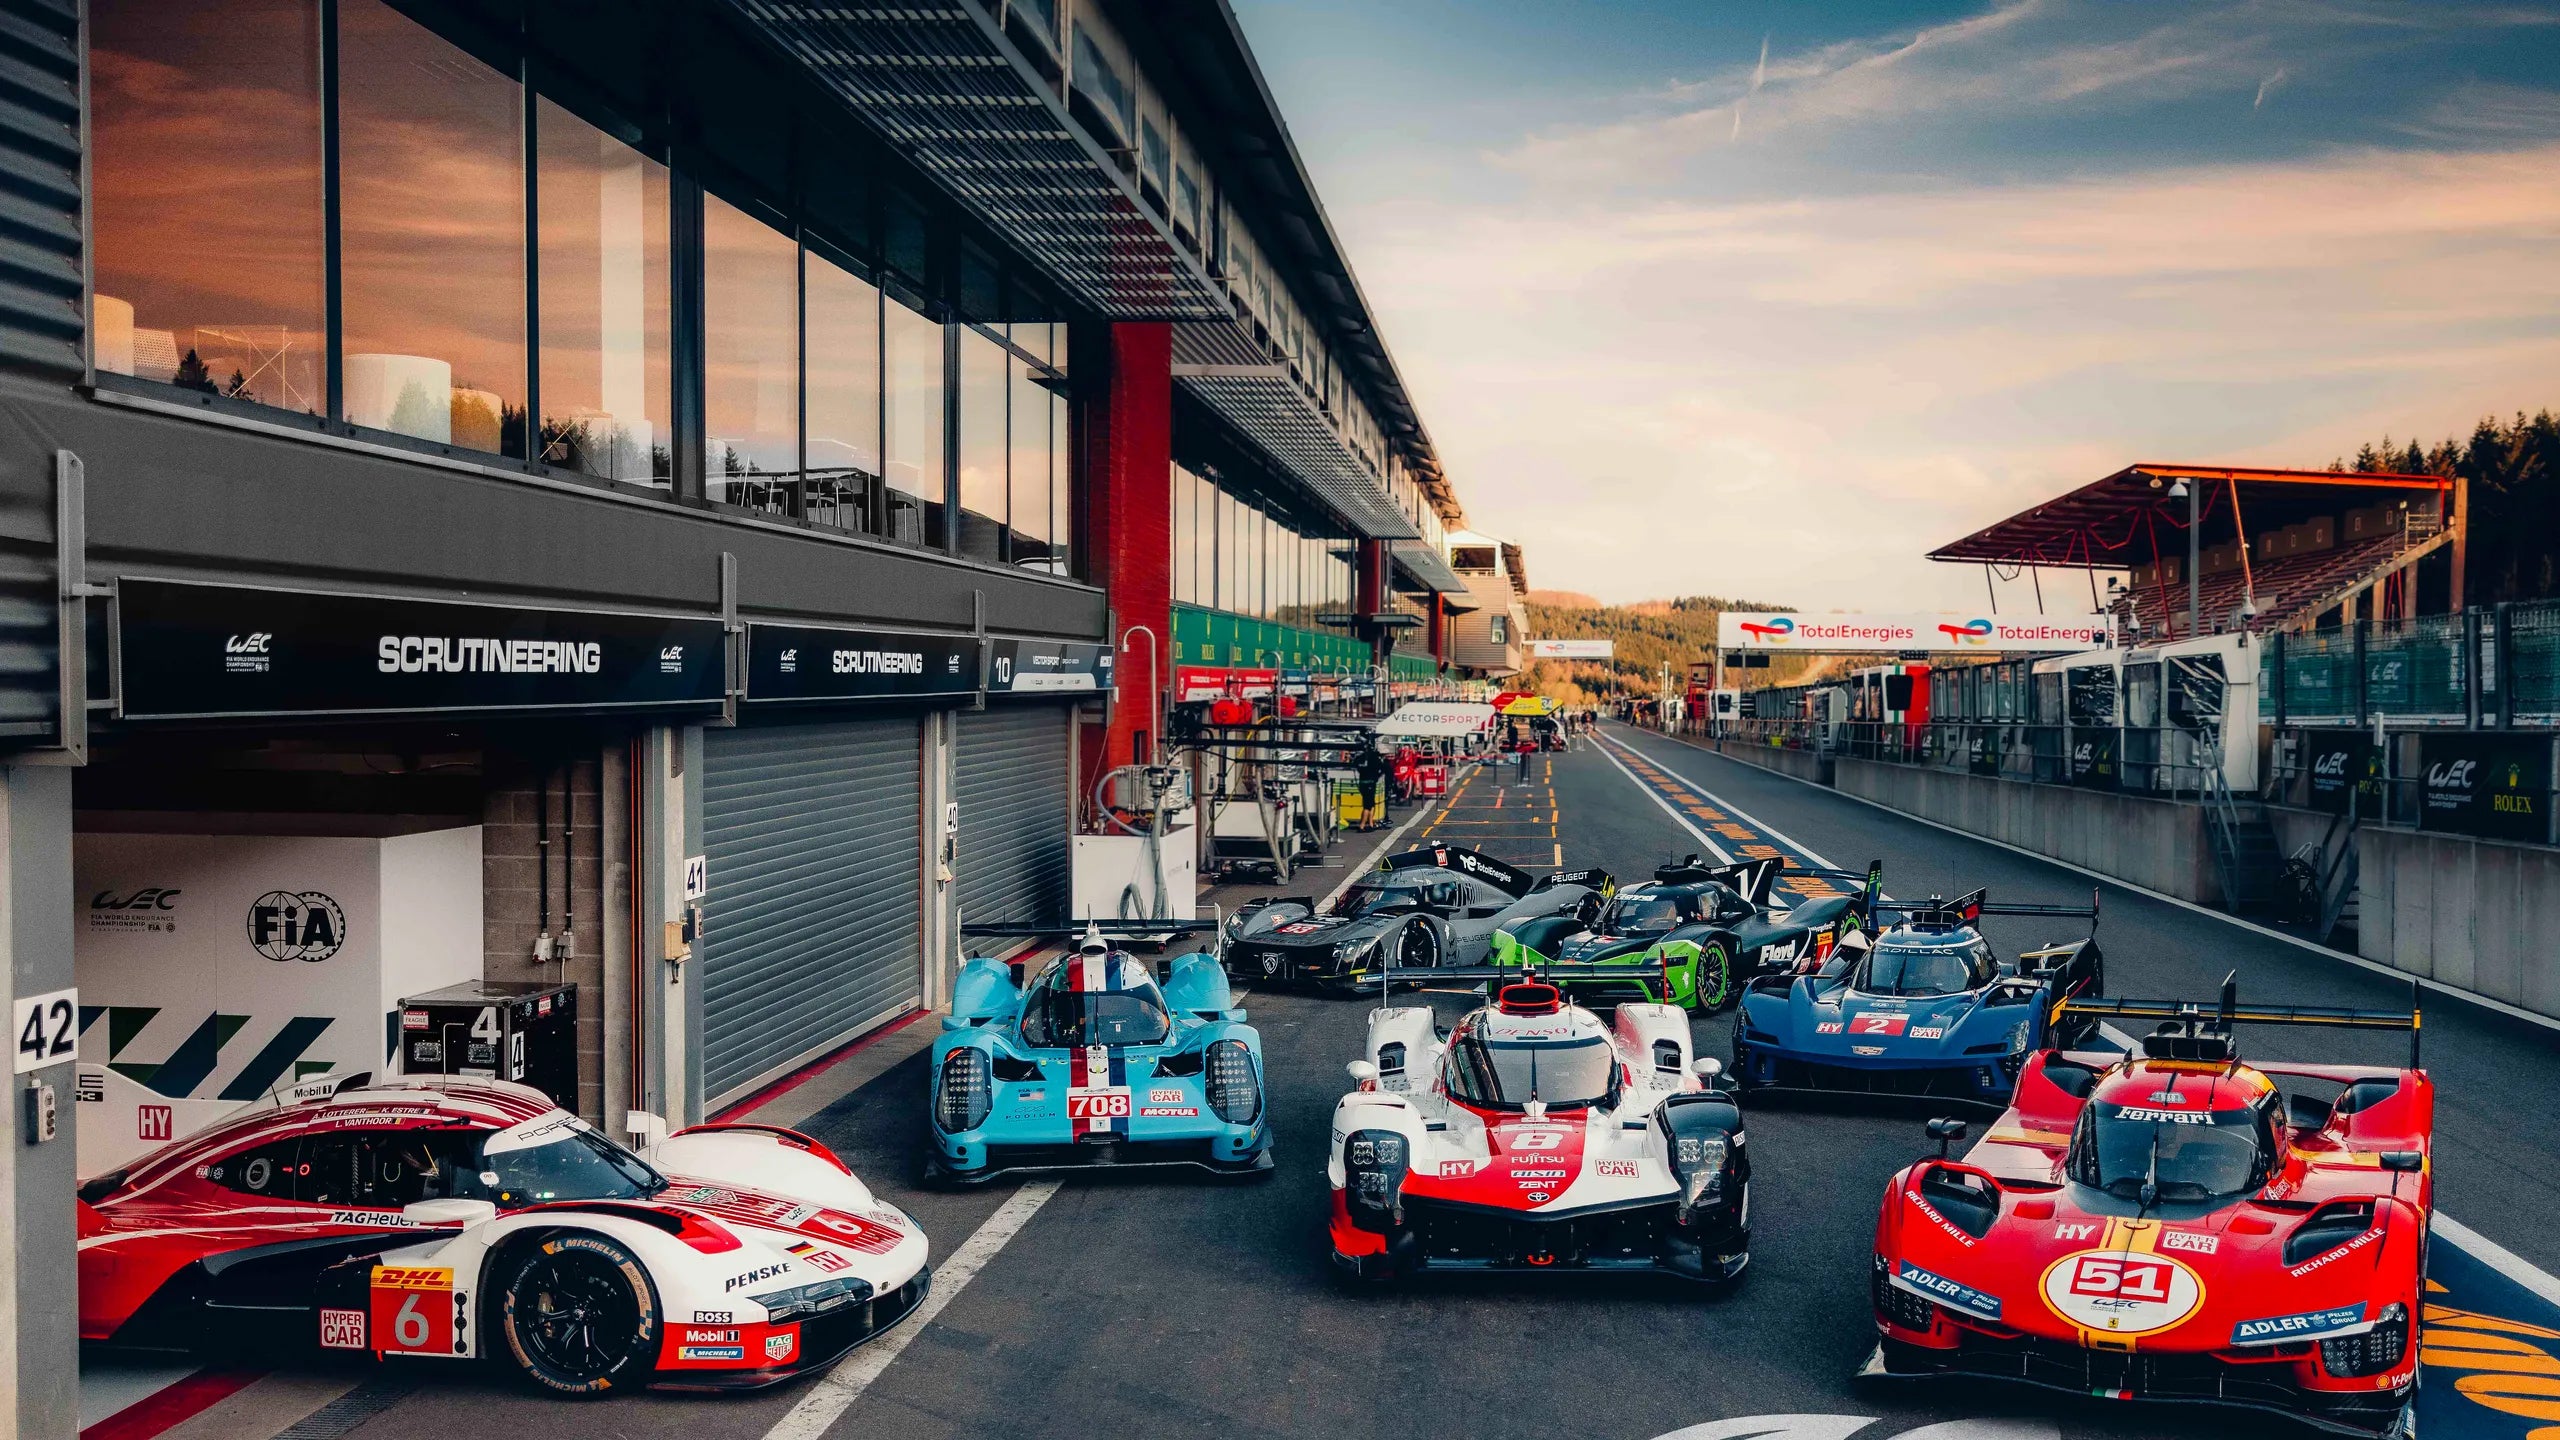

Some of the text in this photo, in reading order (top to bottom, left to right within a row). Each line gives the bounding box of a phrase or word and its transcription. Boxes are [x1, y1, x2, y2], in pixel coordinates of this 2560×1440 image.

[1800, 625, 1913, 640] TotalEnergies
[226, 632, 272, 653] WEC
[378, 636, 600, 673] SCRUTINEERING
[833, 650, 923, 674] SCRUTINEERING
[996, 657, 1010, 683] 10
[2428, 760, 2476, 788] WEC
[2494, 794, 2532, 813] ROLEX
[948, 806, 956, 829] 40
[686, 861, 704, 893] 41
[1476, 862, 1512, 883] TotalEnergies
[1551, 871, 1589, 884] PEUGEOT
[91, 888, 182, 910] WEC
[1760, 940, 1796, 967] Floyd
[20, 999, 75, 1060] 42
[471, 1006, 502, 1045] 4
[1496, 1028, 1568, 1036] DENSO
[1818, 1022, 1842, 1032] HY
[1864, 1019, 1890, 1033] 2
[294, 1086, 321, 1098] Mobil
[1152, 1094, 1181, 1102] CAR
[322, 1108, 366, 1118] LOTTERER
[1070, 1096, 1129, 1116] 708
[1143, 1108, 1198, 1116] MOTUL
[140, 1109, 170, 1137] HY
[336, 1117, 392, 1128] L. VANTHOOR
[2114, 1106, 2215, 1125] Ferrari
[1510, 1132, 1563, 1150] 8
[1511, 1153, 1564, 1165] FUJITSU
[1441, 1162, 1471, 1176] HY
[1600, 1166, 1635, 1176] CAR
[814, 1216, 862, 1235] 6
[1905, 1190, 1975, 1248] RICHARD MILLE
[2055, 1224, 2096, 1240] HY
[2168, 1232, 2215, 1243] HYPER
[566, 1239, 624, 1262] MICHELIN
[2167, 1238, 2212, 1252] CAR
[2290, 1227, 2385, 1278] RICHARD MILLE
[805, 1251, 847, 1272] HY
[379, 1269, 445, 1287] DHL
[725, 1262, 792, 1293] PENSKE
[1902, 1269, 1960, 1296] ADLER
[2077, 1262, 2164, 1298] 51
[1971, 1300, 1994, 1311] GROUP
[1976, 1295, 1998, 1306] PELZER
[2091, 1298, 2143, 1309] WEC
[323, 1312, 362, 1326] HYPER
[394, 1293, 430, 1347] 6
[696, 1312, 730, 1322] BOSS
[2327, 1310, 2354, 1318] PELZER
[2331, 1316, 2358, 1324] GROUP
[323, 1325, 362, 1345] CAR
[2240, 1316, 2310, 1337] ADLER
[686, 1330, 724, 1342] Mobil
[767, 1335, 791, 1347] TAG
[767, 1344, 792, 1360] HEUER
